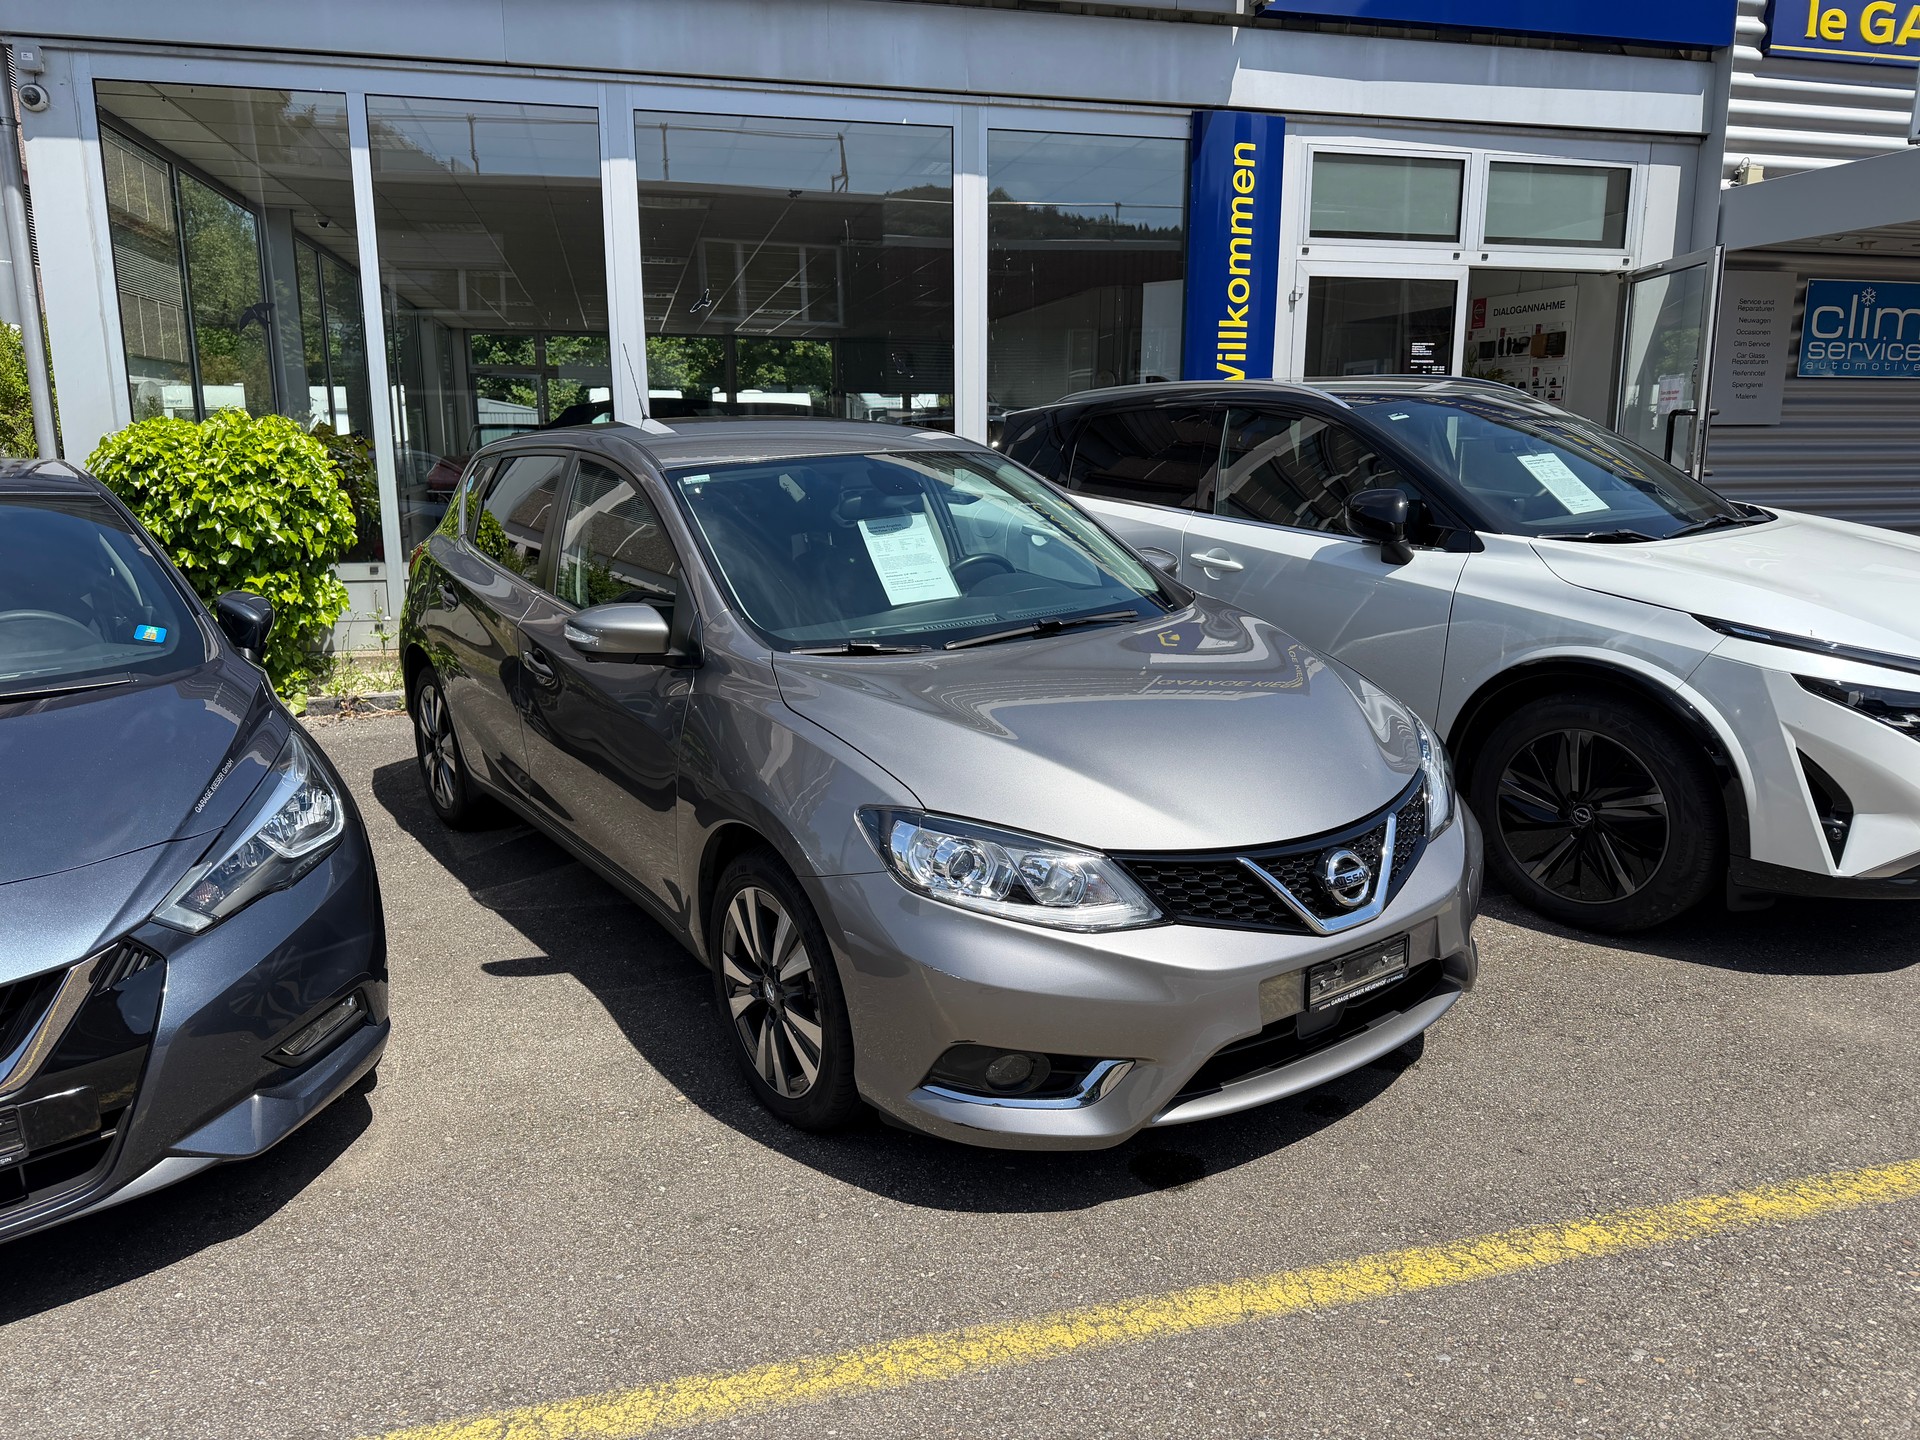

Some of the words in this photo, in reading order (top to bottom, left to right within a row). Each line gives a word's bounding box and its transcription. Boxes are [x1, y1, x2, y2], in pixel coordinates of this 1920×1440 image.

[1804, 0, 1847, 40] le
[1493, 300, 1566, 317] DIALOGANNAHME
[1738, 317, 1772, 325] Neuwagen
[1811, 294, 1920, 340] clim
[1736, 328, 1771, 336] Occasionen
[1807, 335, 1920, 361] service
[1731, 358, 1769, 366] Reparaturen
[1805, 361, 1920, 371] automotive
[1732, 369, 1766, 377] Reifenhotel
[1731, 381, 1764, 389] Spenglerei
[194, 789, 214, 813] GARAGE
[210, 772, 225, 792] KIESER
[221, 757, 234, 775] GmbH
[1332, 867, 1369, 889] NISSAN
[1330, 995, 1349, 1006] GARAGE
